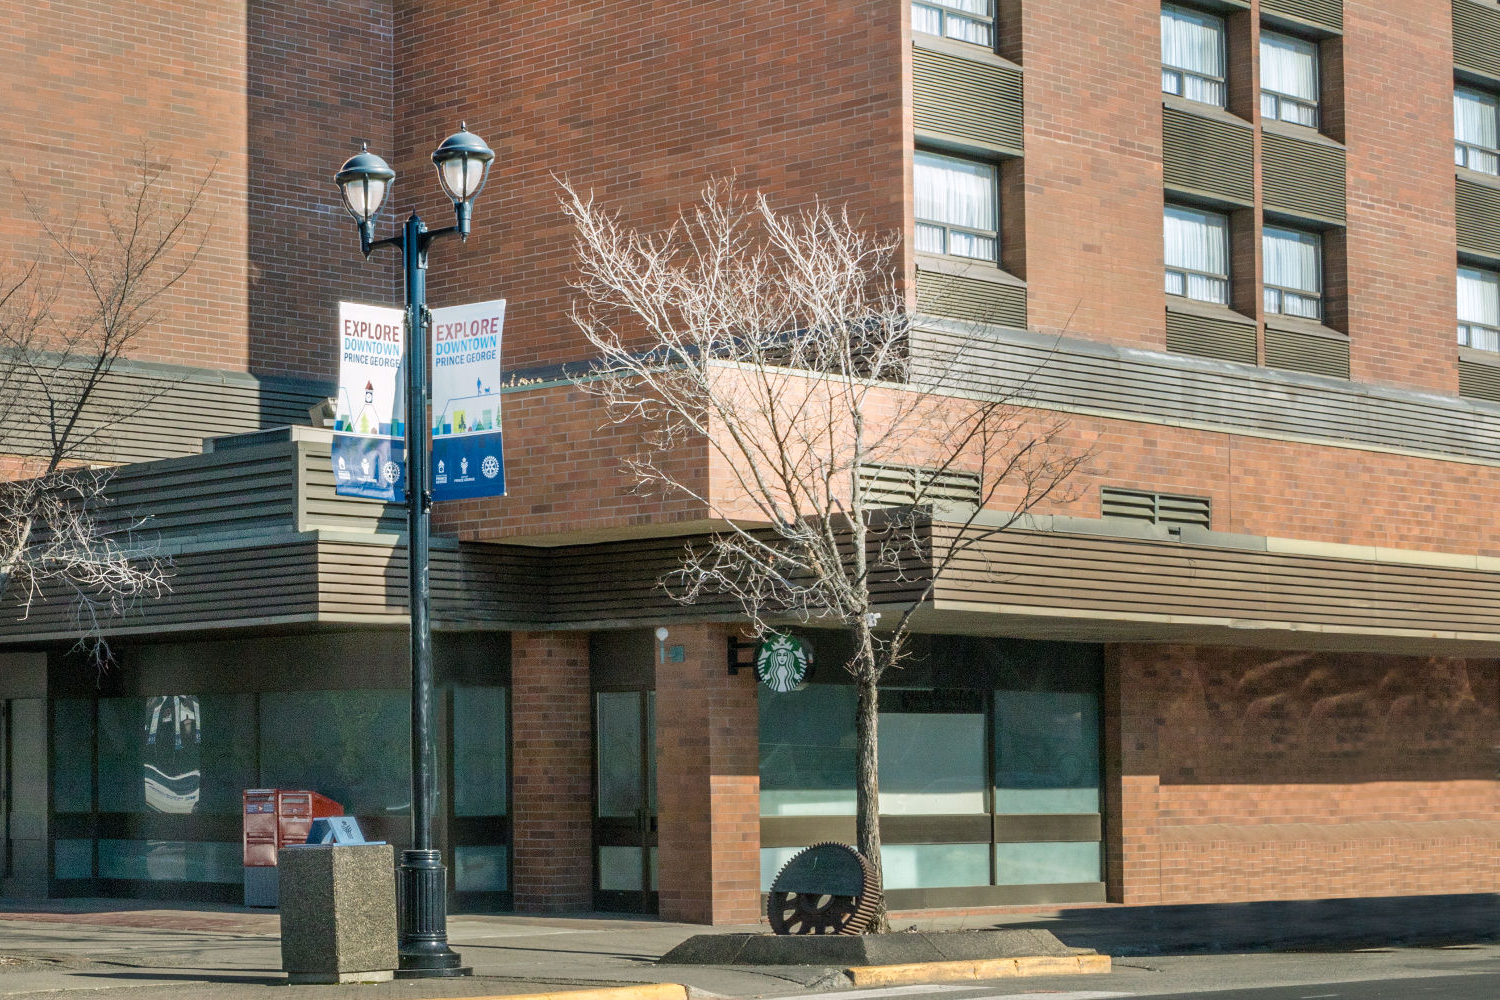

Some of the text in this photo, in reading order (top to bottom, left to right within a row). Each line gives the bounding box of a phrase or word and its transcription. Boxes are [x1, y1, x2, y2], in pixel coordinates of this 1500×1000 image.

[344, 319, 400, 343] EXPLORE
[436, 317, 499, 342] EXPLORE
[344, 337, 400, 356] DOWNTOWN
[435, 335, 497, 356] DOWNTOWN
[344, 352, 400, 369] PRINCE GEORGE
[435, 349, 497, 367] PRINCE GEORGE
